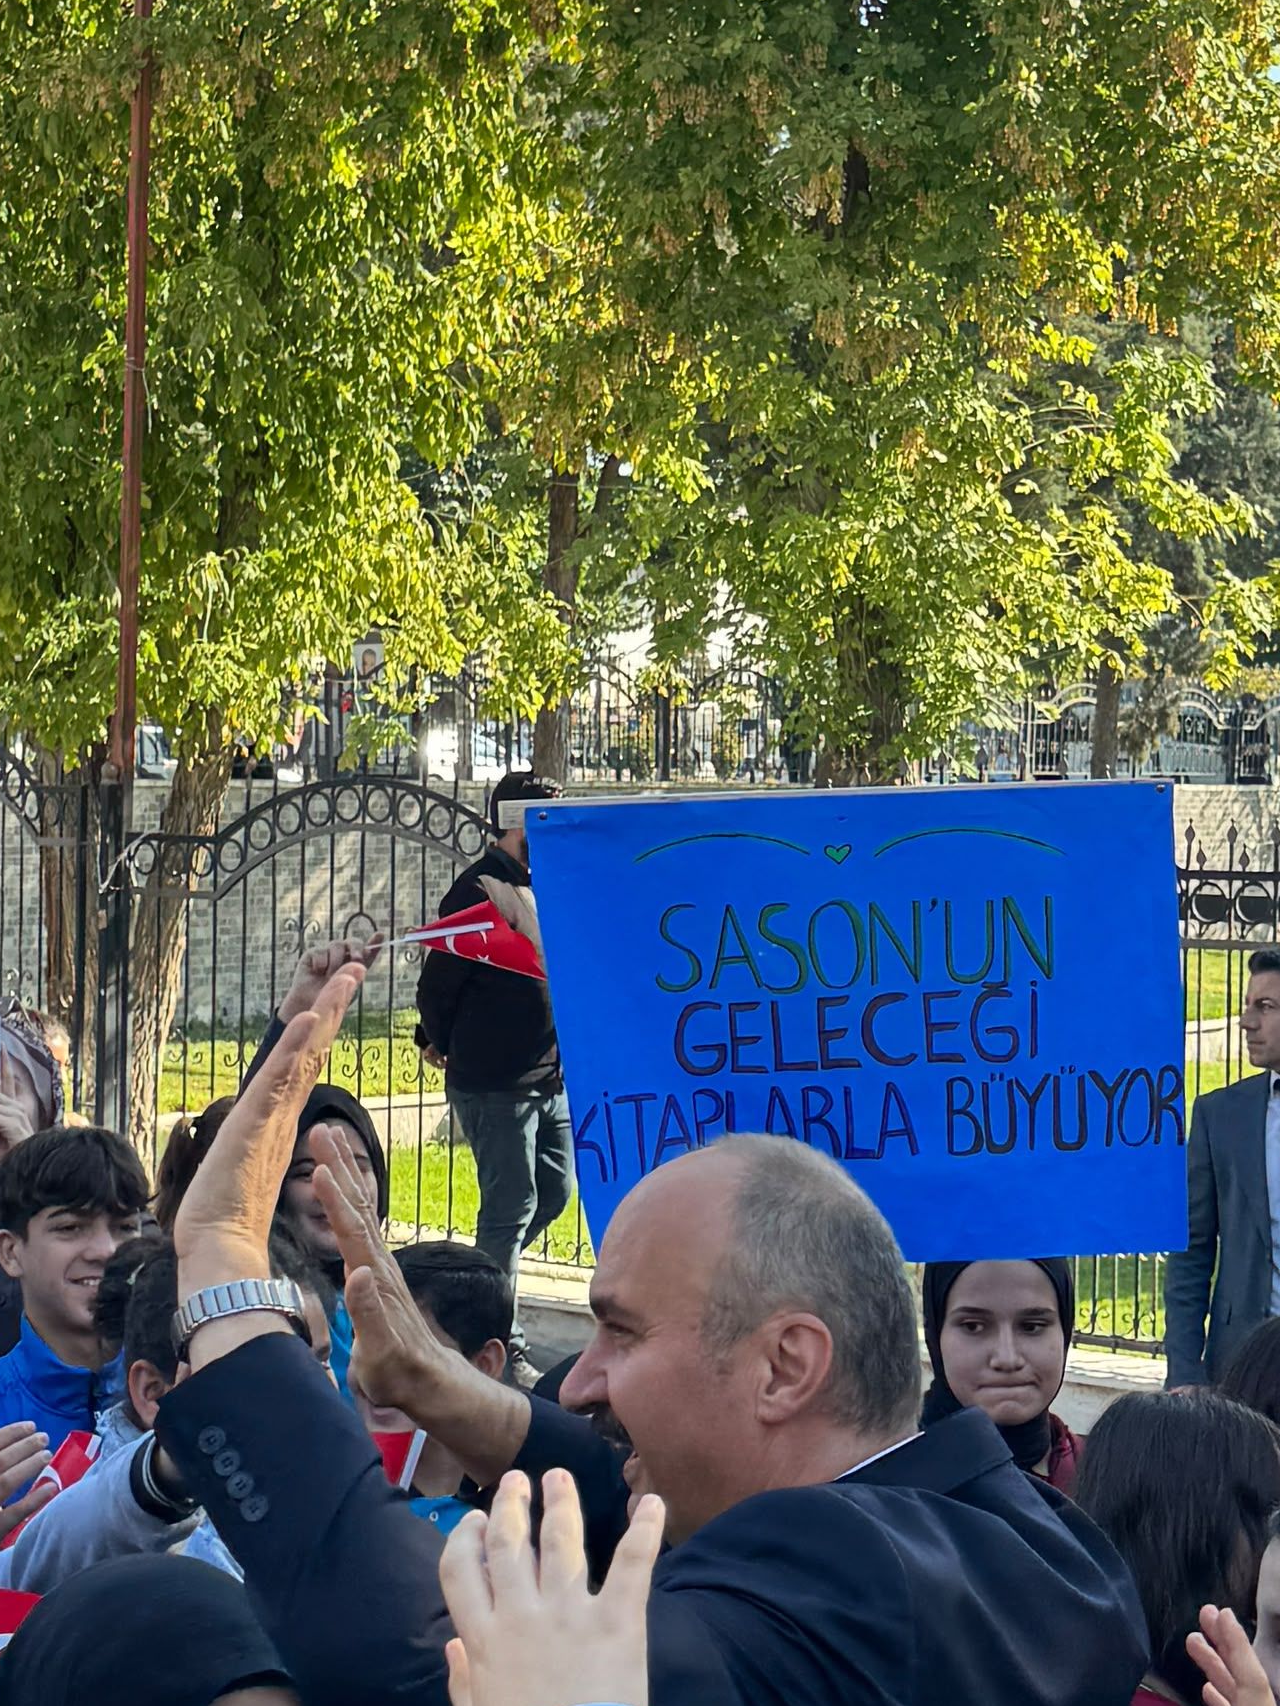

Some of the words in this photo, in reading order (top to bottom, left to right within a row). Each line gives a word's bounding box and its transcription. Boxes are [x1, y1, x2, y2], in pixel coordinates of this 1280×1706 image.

[654, 894, 1055, 994] SASON'UN
[672, 979, 1040, 1077] GELECEĞİ
[945, 1064, 1187, 1157] BÜYÜYOR
